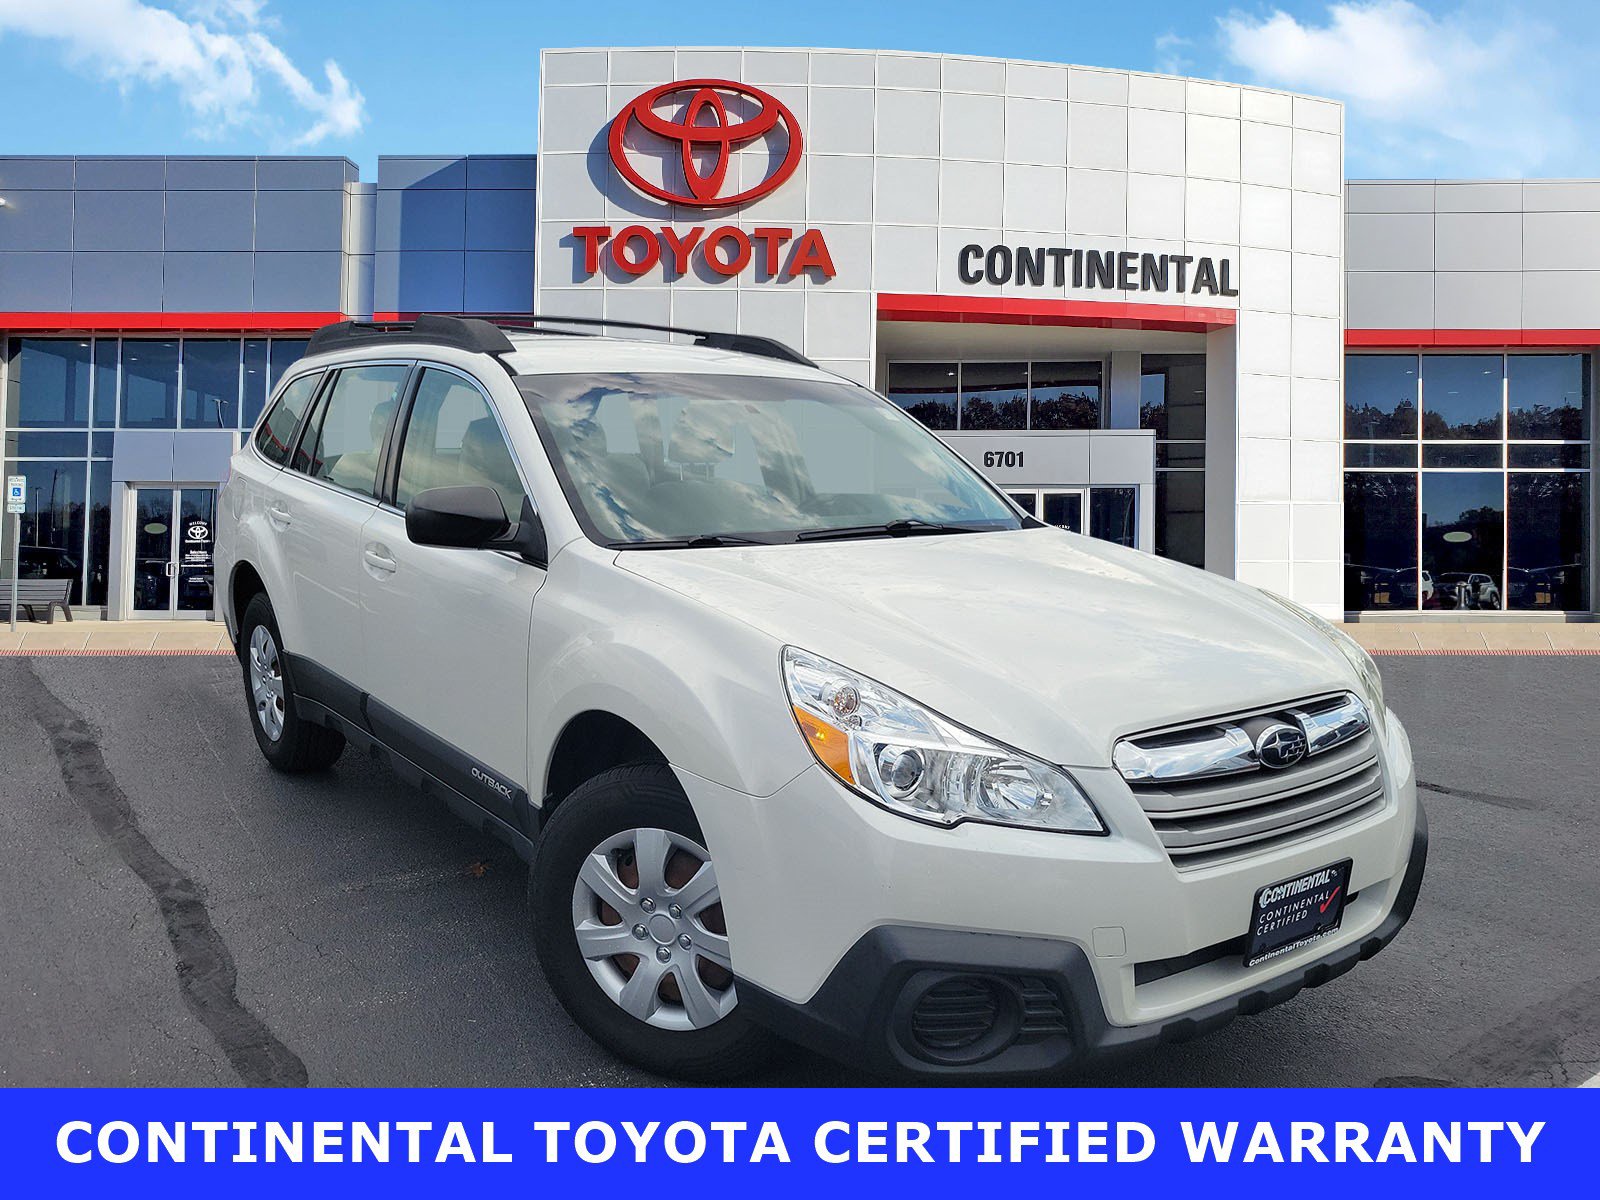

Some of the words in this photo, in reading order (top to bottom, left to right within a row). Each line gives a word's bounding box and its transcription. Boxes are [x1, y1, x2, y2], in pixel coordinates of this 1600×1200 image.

[573, 224, 837, 277] TOYOTA
[958, 243, 1239, 297] CONTINENTAL
[983, 451, 1024, 468] 6701
[471, 767, 512, 800] OUTBACK
[1259, 868, 1331, 909] CONTINENTAL
[1257, 910, 1308, 936] CERTIFIED
[1259, 891, 1330, 924] CONTINENTAL
[1249, 927, 1340, 967] ContinentalToyota.com
